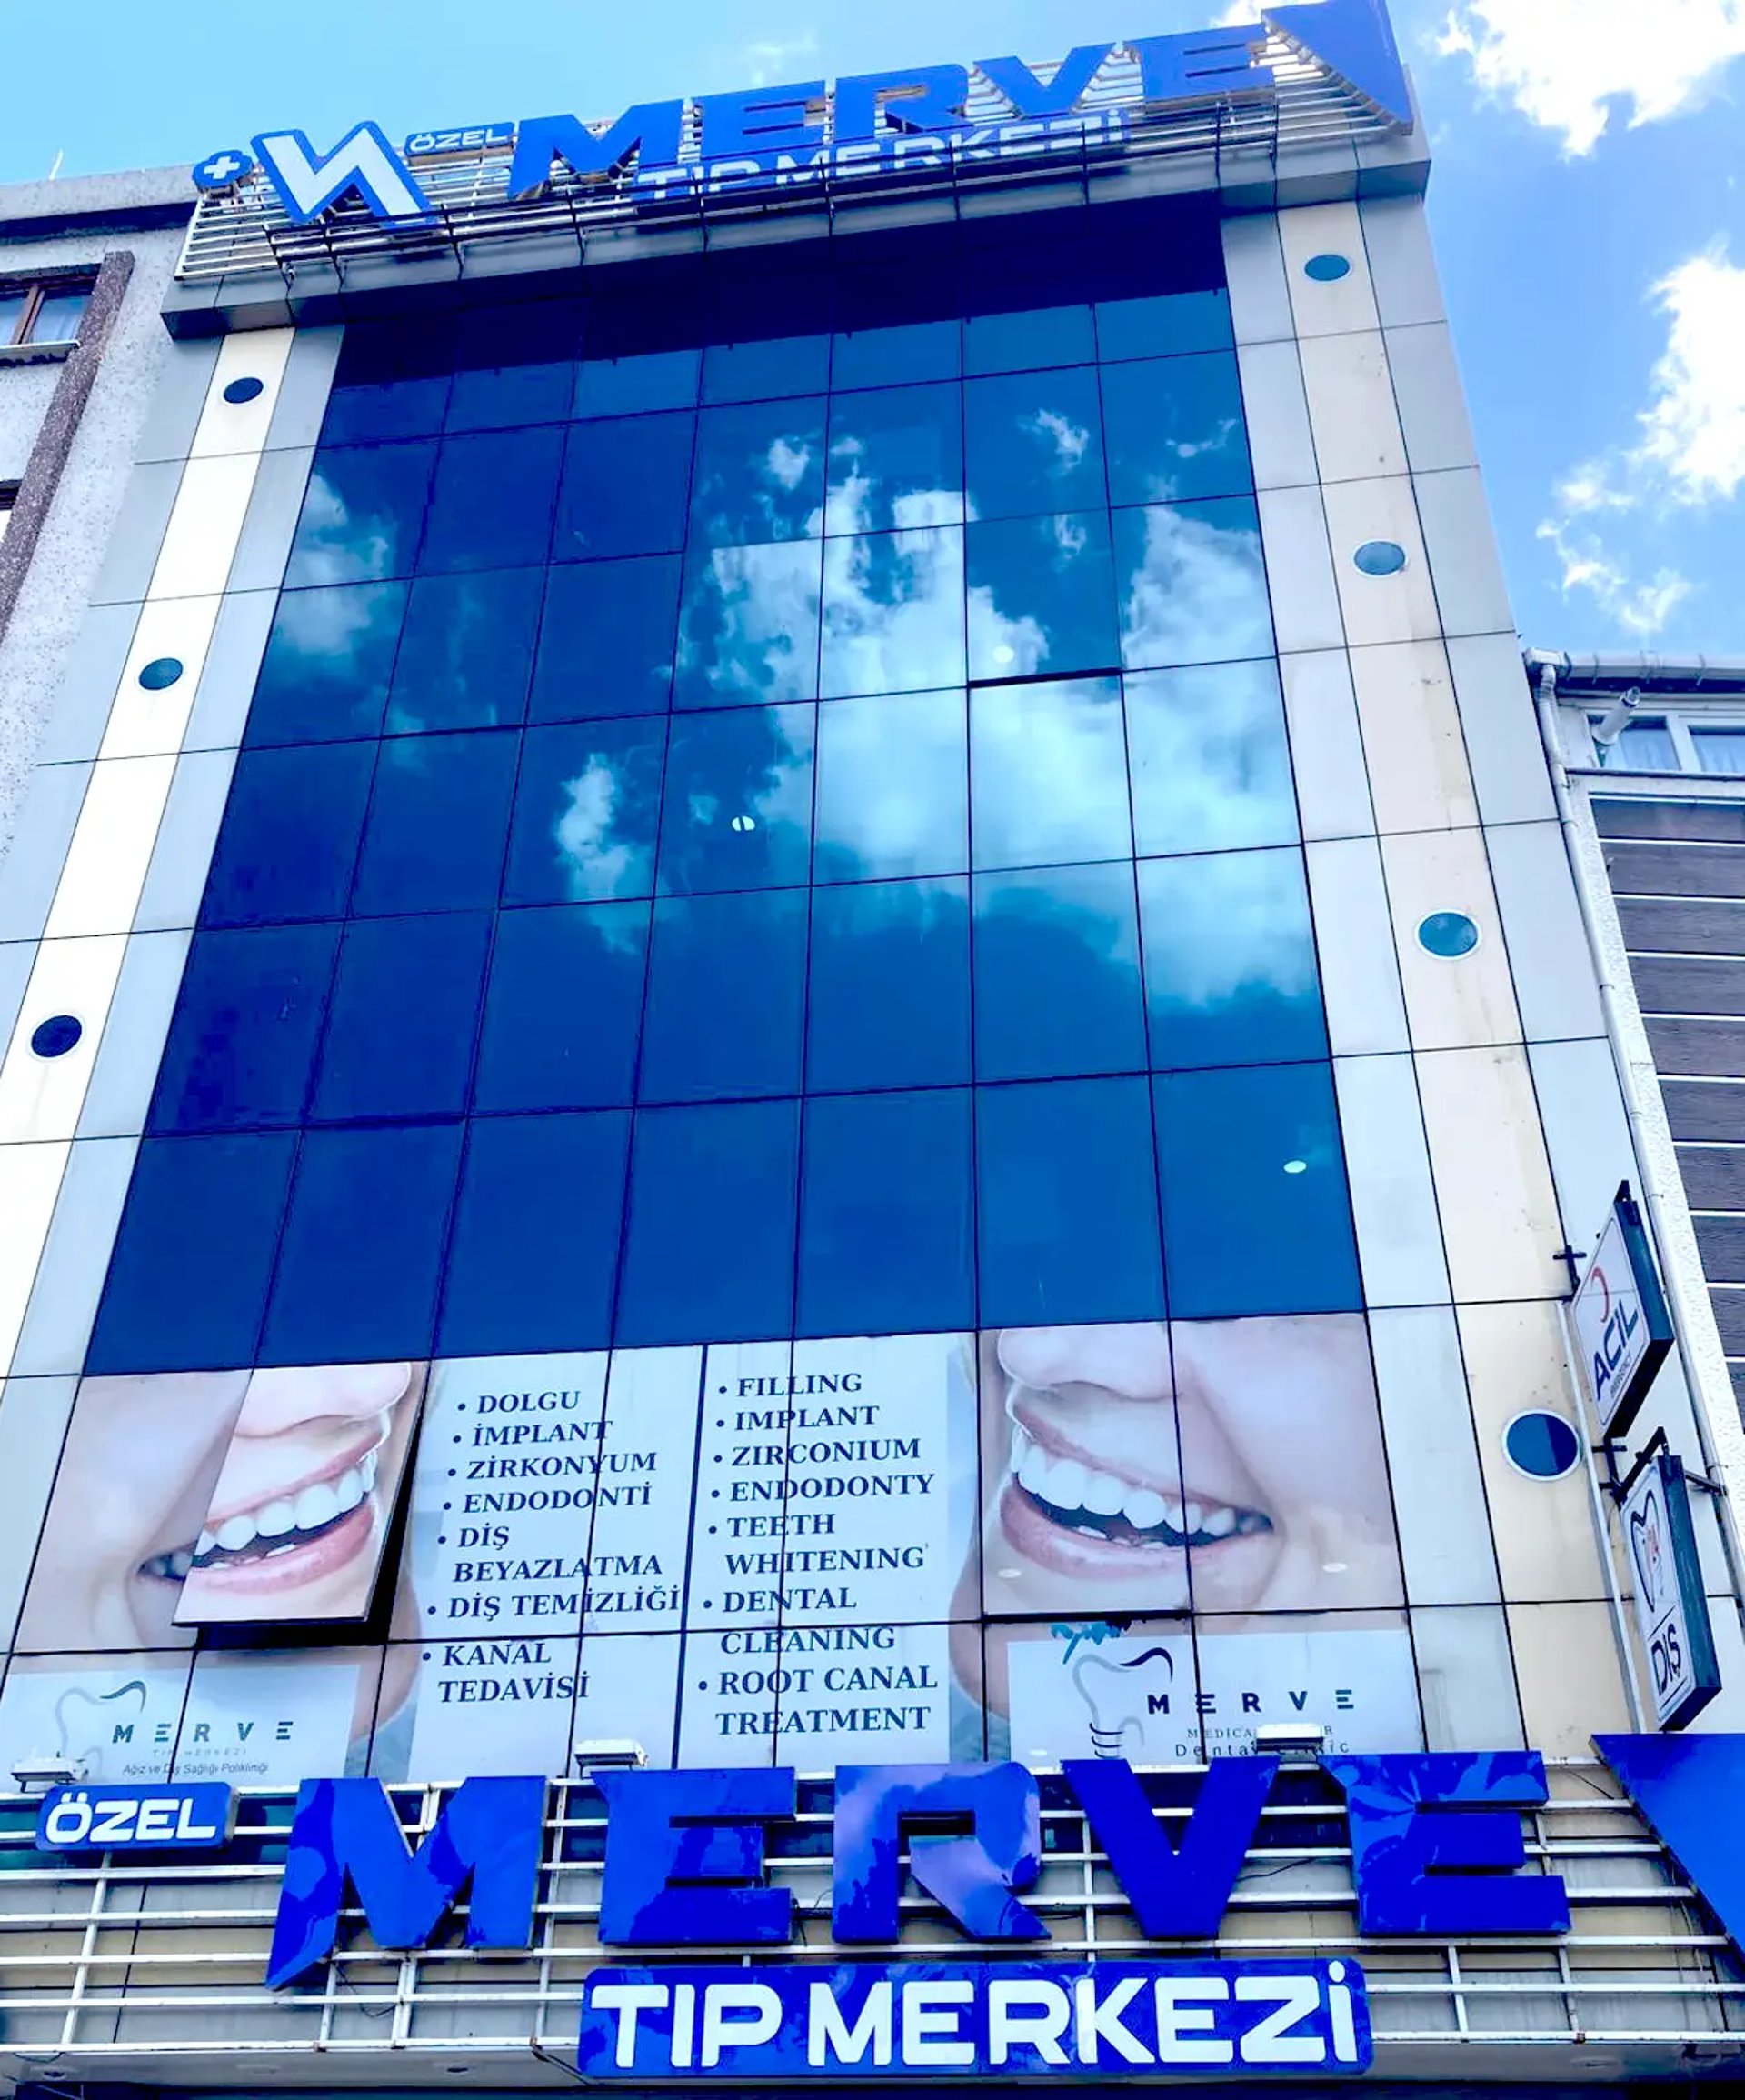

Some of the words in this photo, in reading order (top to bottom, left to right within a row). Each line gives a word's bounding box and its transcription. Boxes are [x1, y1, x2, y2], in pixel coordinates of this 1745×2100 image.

[507, 25, 1274, 199] MERVE
[409, 125, 510, 153] ÖZEL
[737, 1373, 863, 1396] FILLING
[477, 1391, 581, 1414] DOLGU
[734, 1405, 880, 1431] IMPLANT
[472, 1421, 613, 1446] İMPLANT
[466, 1452, 656, 1480] ZİRKONYUM
[732, 1438, 921, 1466] ZIRCONIUM
[463, 1481, 652, 1513] ENDODONTİ
[730, 1474, 935, 1502] ENDODONTY
[457, 1523, 510, 1550] DİŞ
[727, 1514, 835, 1537] TEETH
[453, 1555, 663, 1583] BEYAZLATMA
[725, 1547, 924, 1575] WHITENING
[447, 1593, 501, 1621] DİŞ
[512, 1585, 680, 1615] TEMİZLİĞİ
[723, 1587, 857, 1612] DENTAL
[721, 1627, 894, 1654] CLEANING
[442, 1643, 552, 1667] KANAL
[438, 1671, 590, 1703] TEDAVİSİ
[718, 1670, 814, 1695] ROOT
[824, 1666, 938, 1692] CANAL
[1148, 1689, 1354, 1715] MERVE
[112, 1721, 294, 1744] MERVE
[715, 1707, 931, 1735] TREATMENT
[1187, 1728, 1256, 1738] MEDICA
[1175, 1744, 1257, 1756] Denta
[45, 1791, 216, 1844] ÖZEL
[265, 1749, 1571, 1991] MERVE
[590, 1982, 783, 2068] TIP
[807, 1959, 1360, 2067] MERKEZİ
